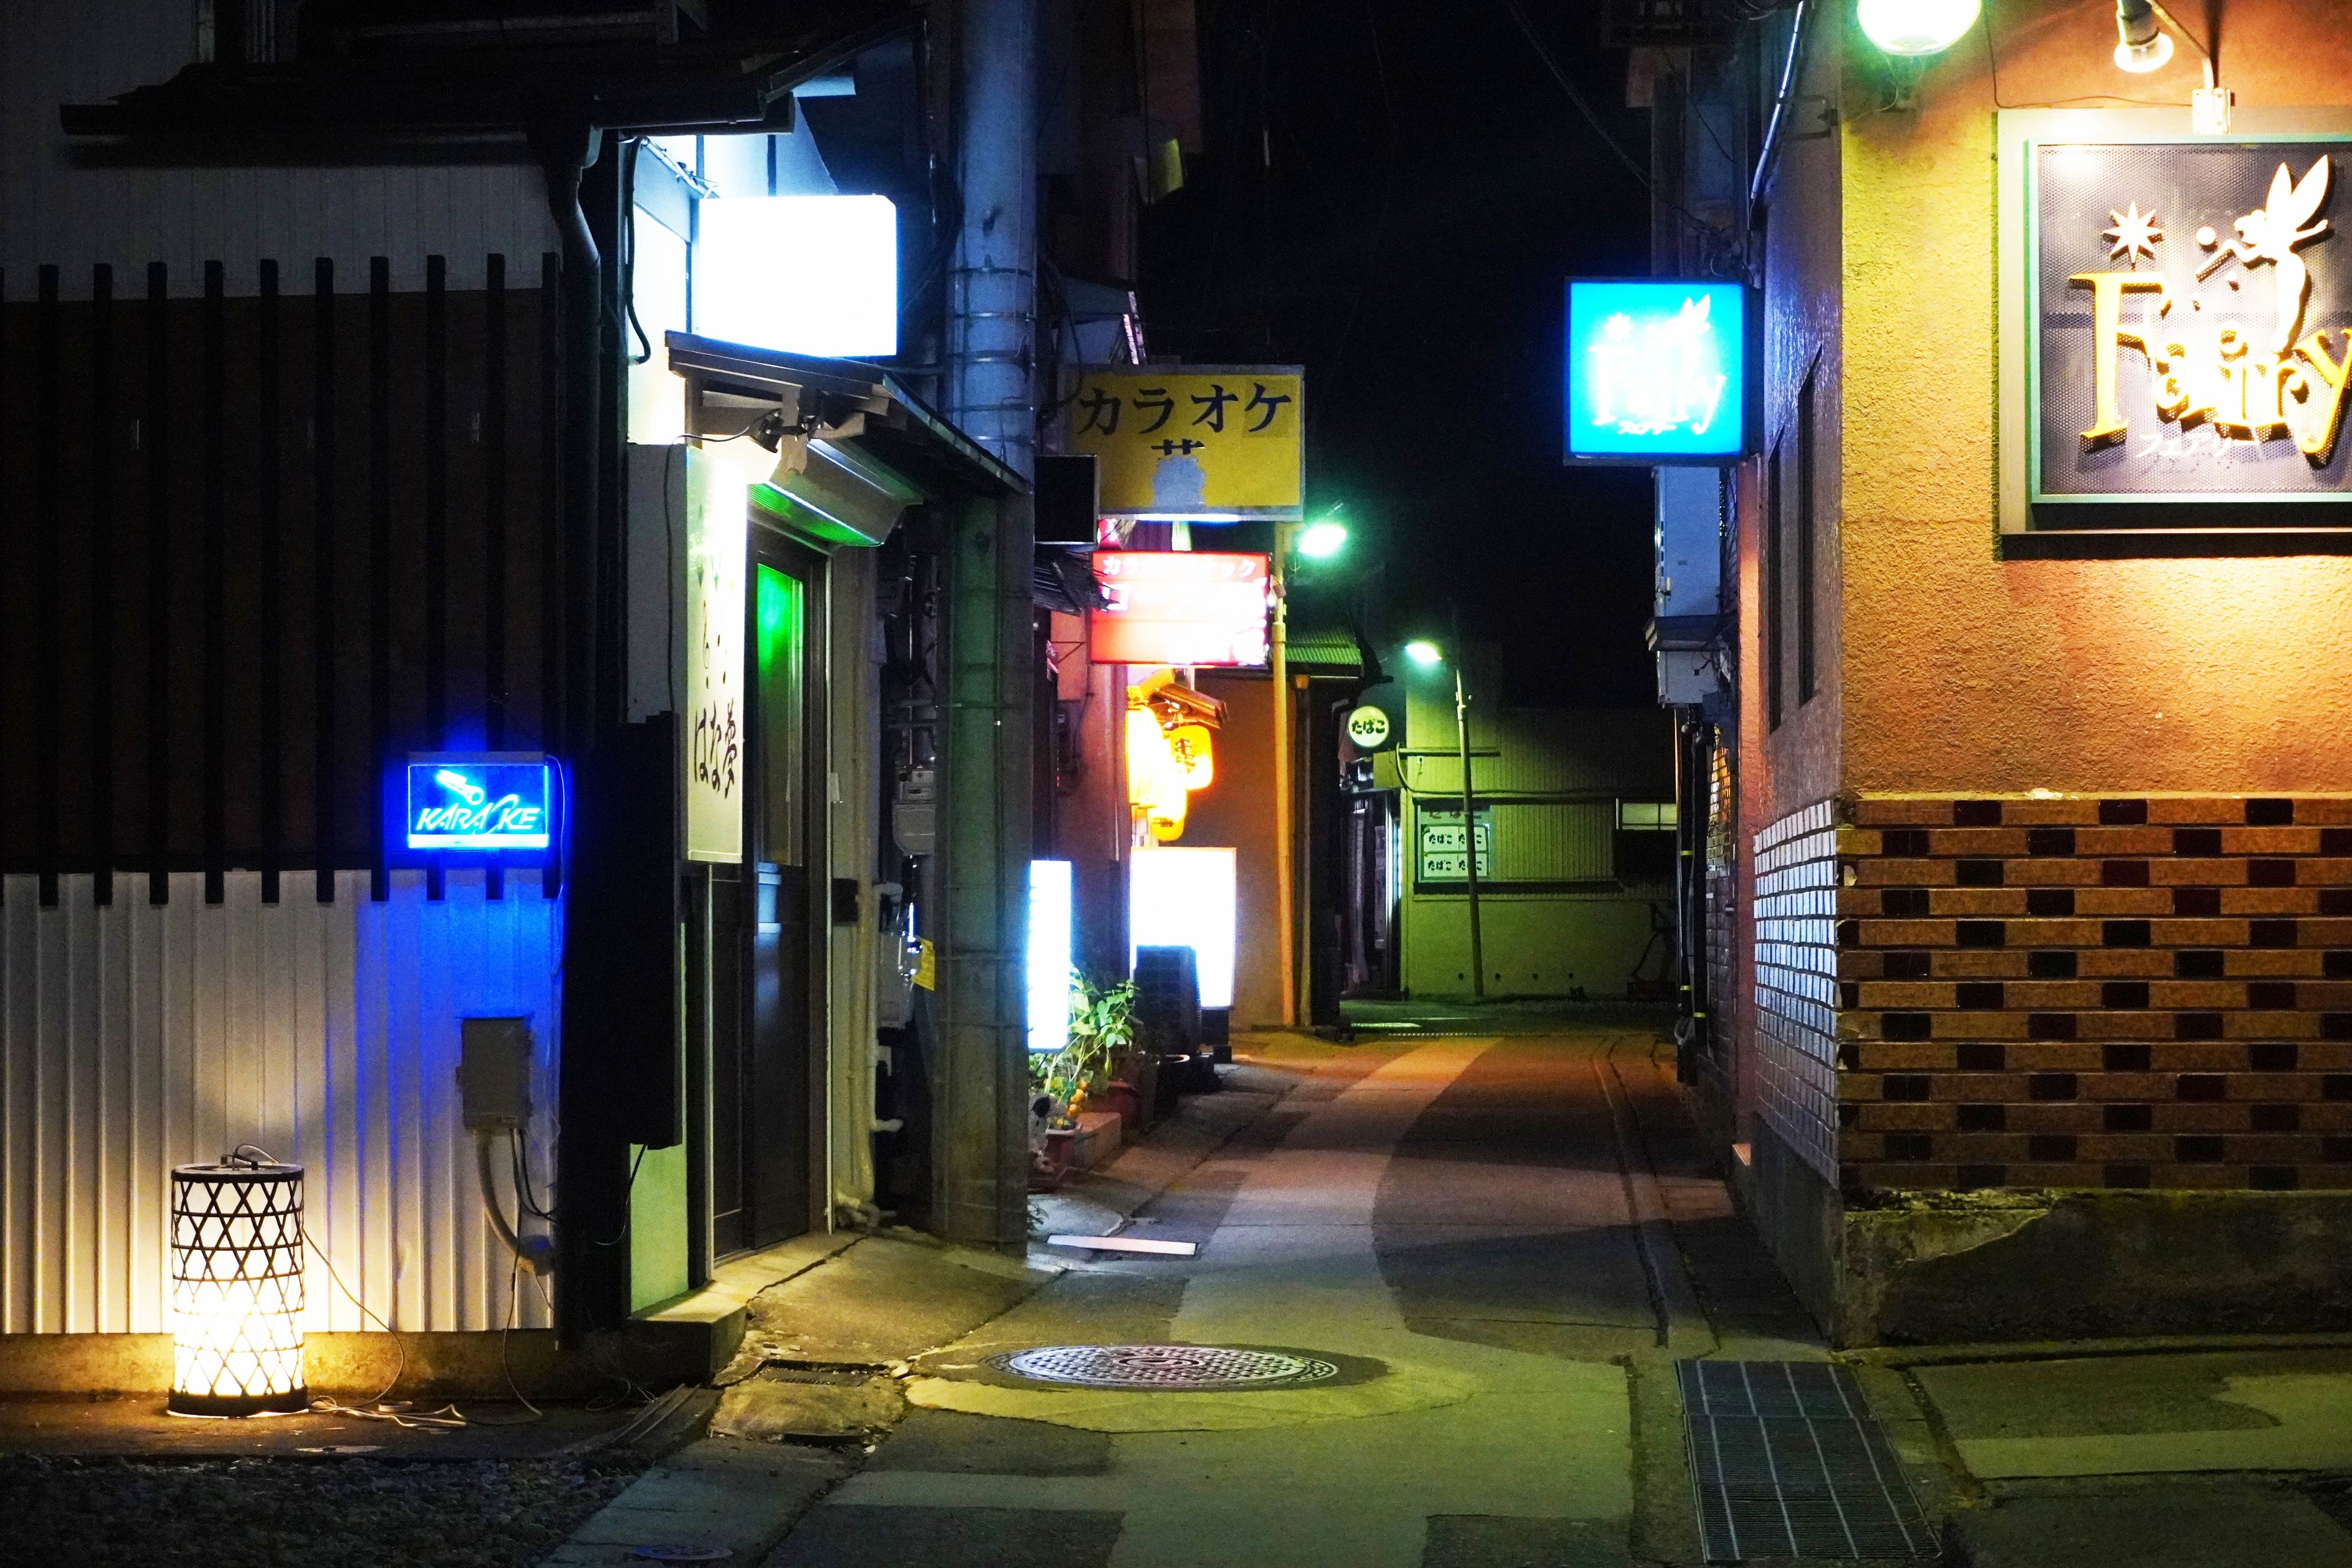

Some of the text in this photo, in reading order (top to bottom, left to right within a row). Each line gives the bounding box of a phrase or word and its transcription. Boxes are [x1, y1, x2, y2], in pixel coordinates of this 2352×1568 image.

[2067, 271, 2352, 454] Fairy
[1077, 382, 1292, 437] カラオケ
[2135, 432, 2260, 457] フェアリー
[1351, 718, 1385, 735] たばこ
[1429, 833, 1452, 844] たばこ
[1427, 860, 1452, 871] たばこ
